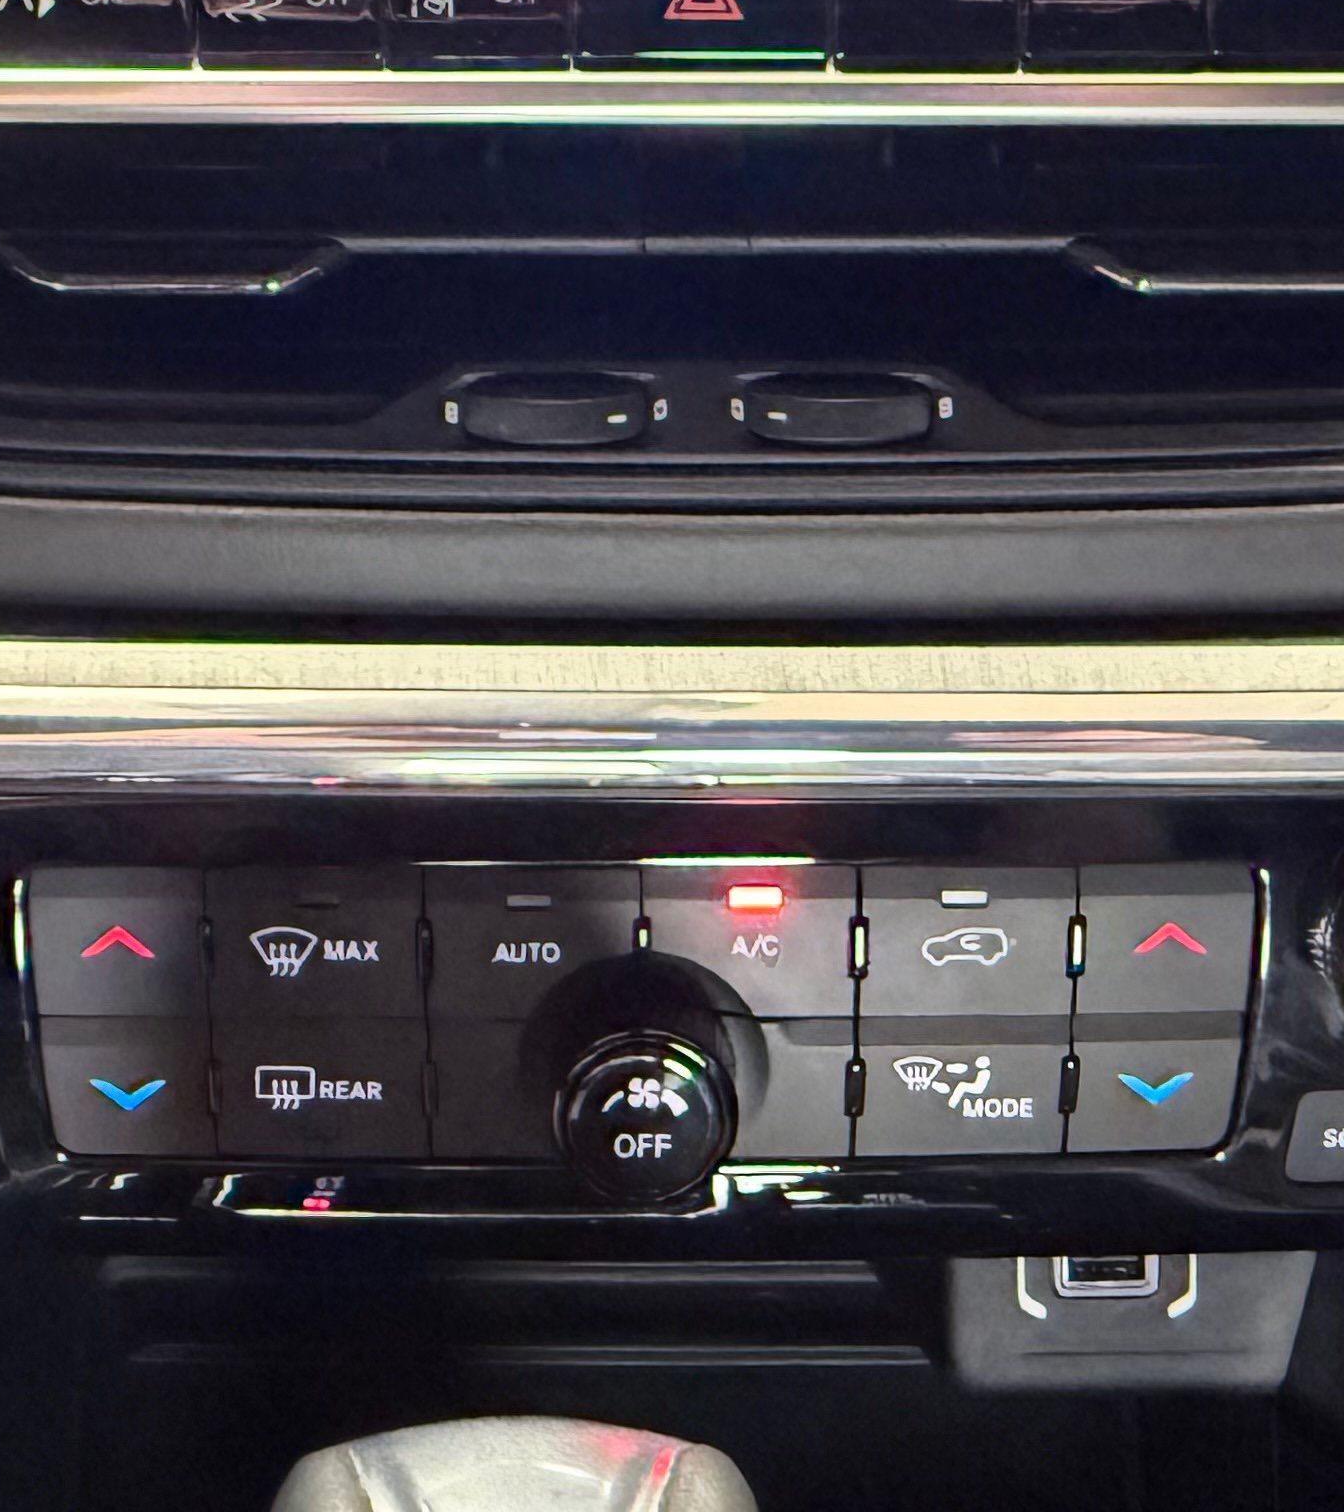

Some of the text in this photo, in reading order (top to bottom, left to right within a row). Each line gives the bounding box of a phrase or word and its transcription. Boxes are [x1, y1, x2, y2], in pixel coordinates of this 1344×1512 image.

[324, 940, 379, 961] MAX
[492, 943, 560, 963] AUTO
[731, 934, 778, 959] A/C
[320, 1081, 382, 1099] REAR
[963, 1096, 1033, 1118] MODE
[614, 1134, 672, 1158] OFF
